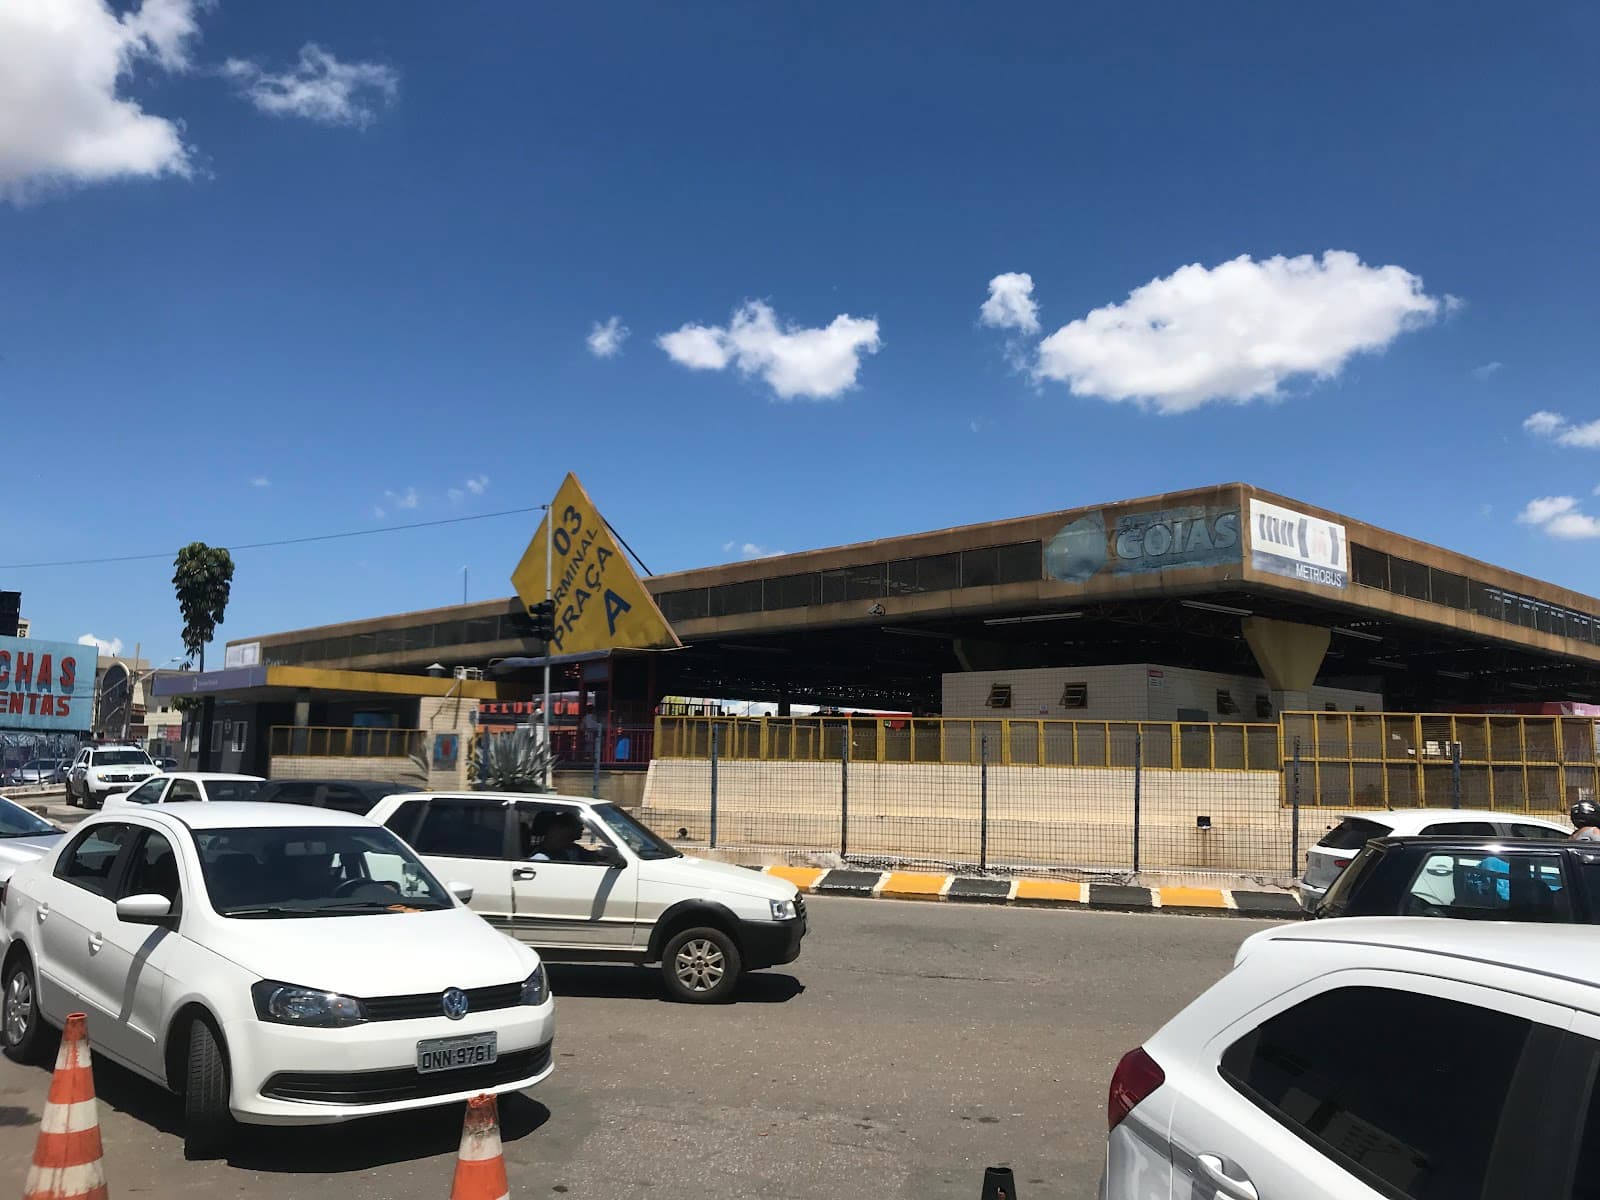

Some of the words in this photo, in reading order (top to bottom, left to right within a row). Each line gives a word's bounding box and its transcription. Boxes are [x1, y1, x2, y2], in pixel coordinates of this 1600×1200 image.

[553, 505, 582, 556] 03
[553, 546, 613, 651] PRAÇA
[1295, 563, 1342, 587] METROBUS
[604, 588, 632, 636] A
